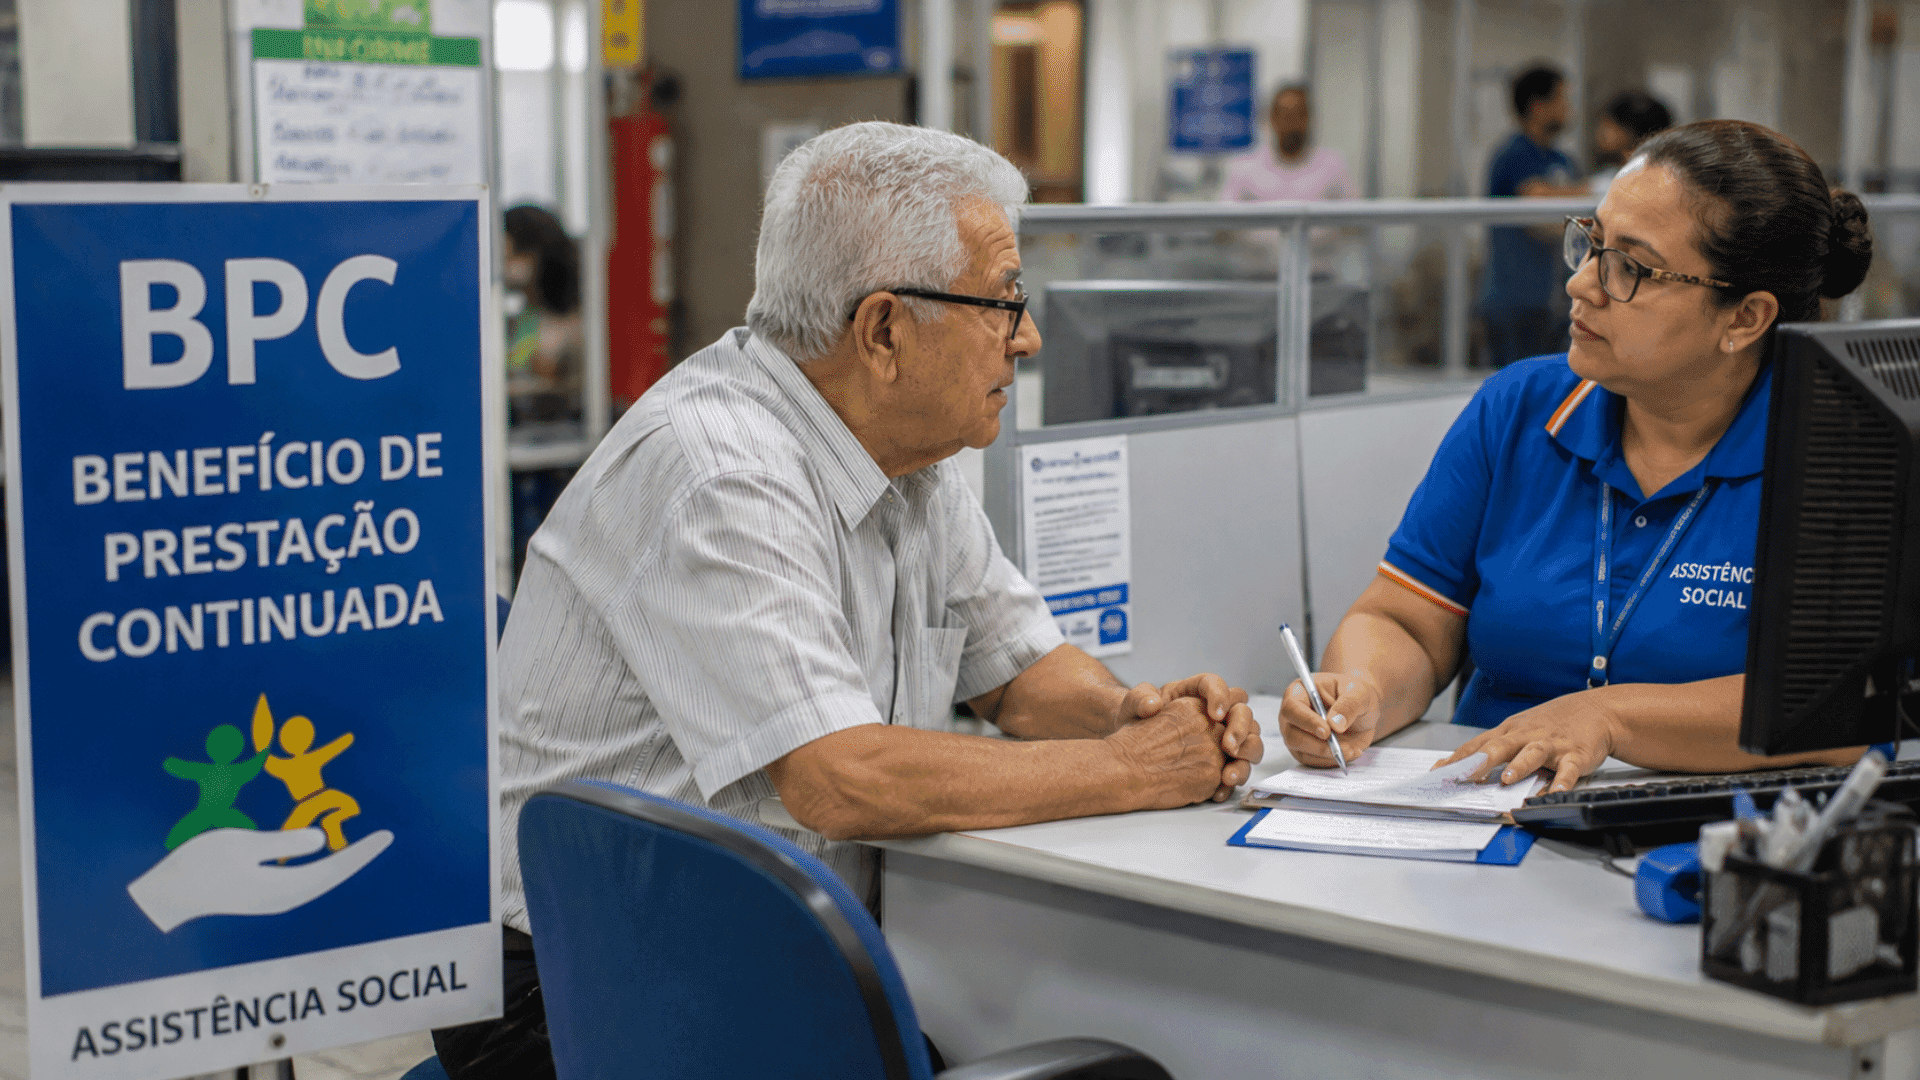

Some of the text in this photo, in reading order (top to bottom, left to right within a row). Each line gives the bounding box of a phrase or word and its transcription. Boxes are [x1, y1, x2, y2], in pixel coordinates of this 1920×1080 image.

[119, 254, 402, 390] BPC
[73, 431, 443, 505] BENEFÍCIO DE
[104, 500, 420, 582] PRESTAÇÃO
[78, 579, 444, 662] CONTINUADA
[1679, 586, 1747, 609] SOCIAL
[71, 961, 468, 1061] ASSISTÊNCIA SOCIAL
